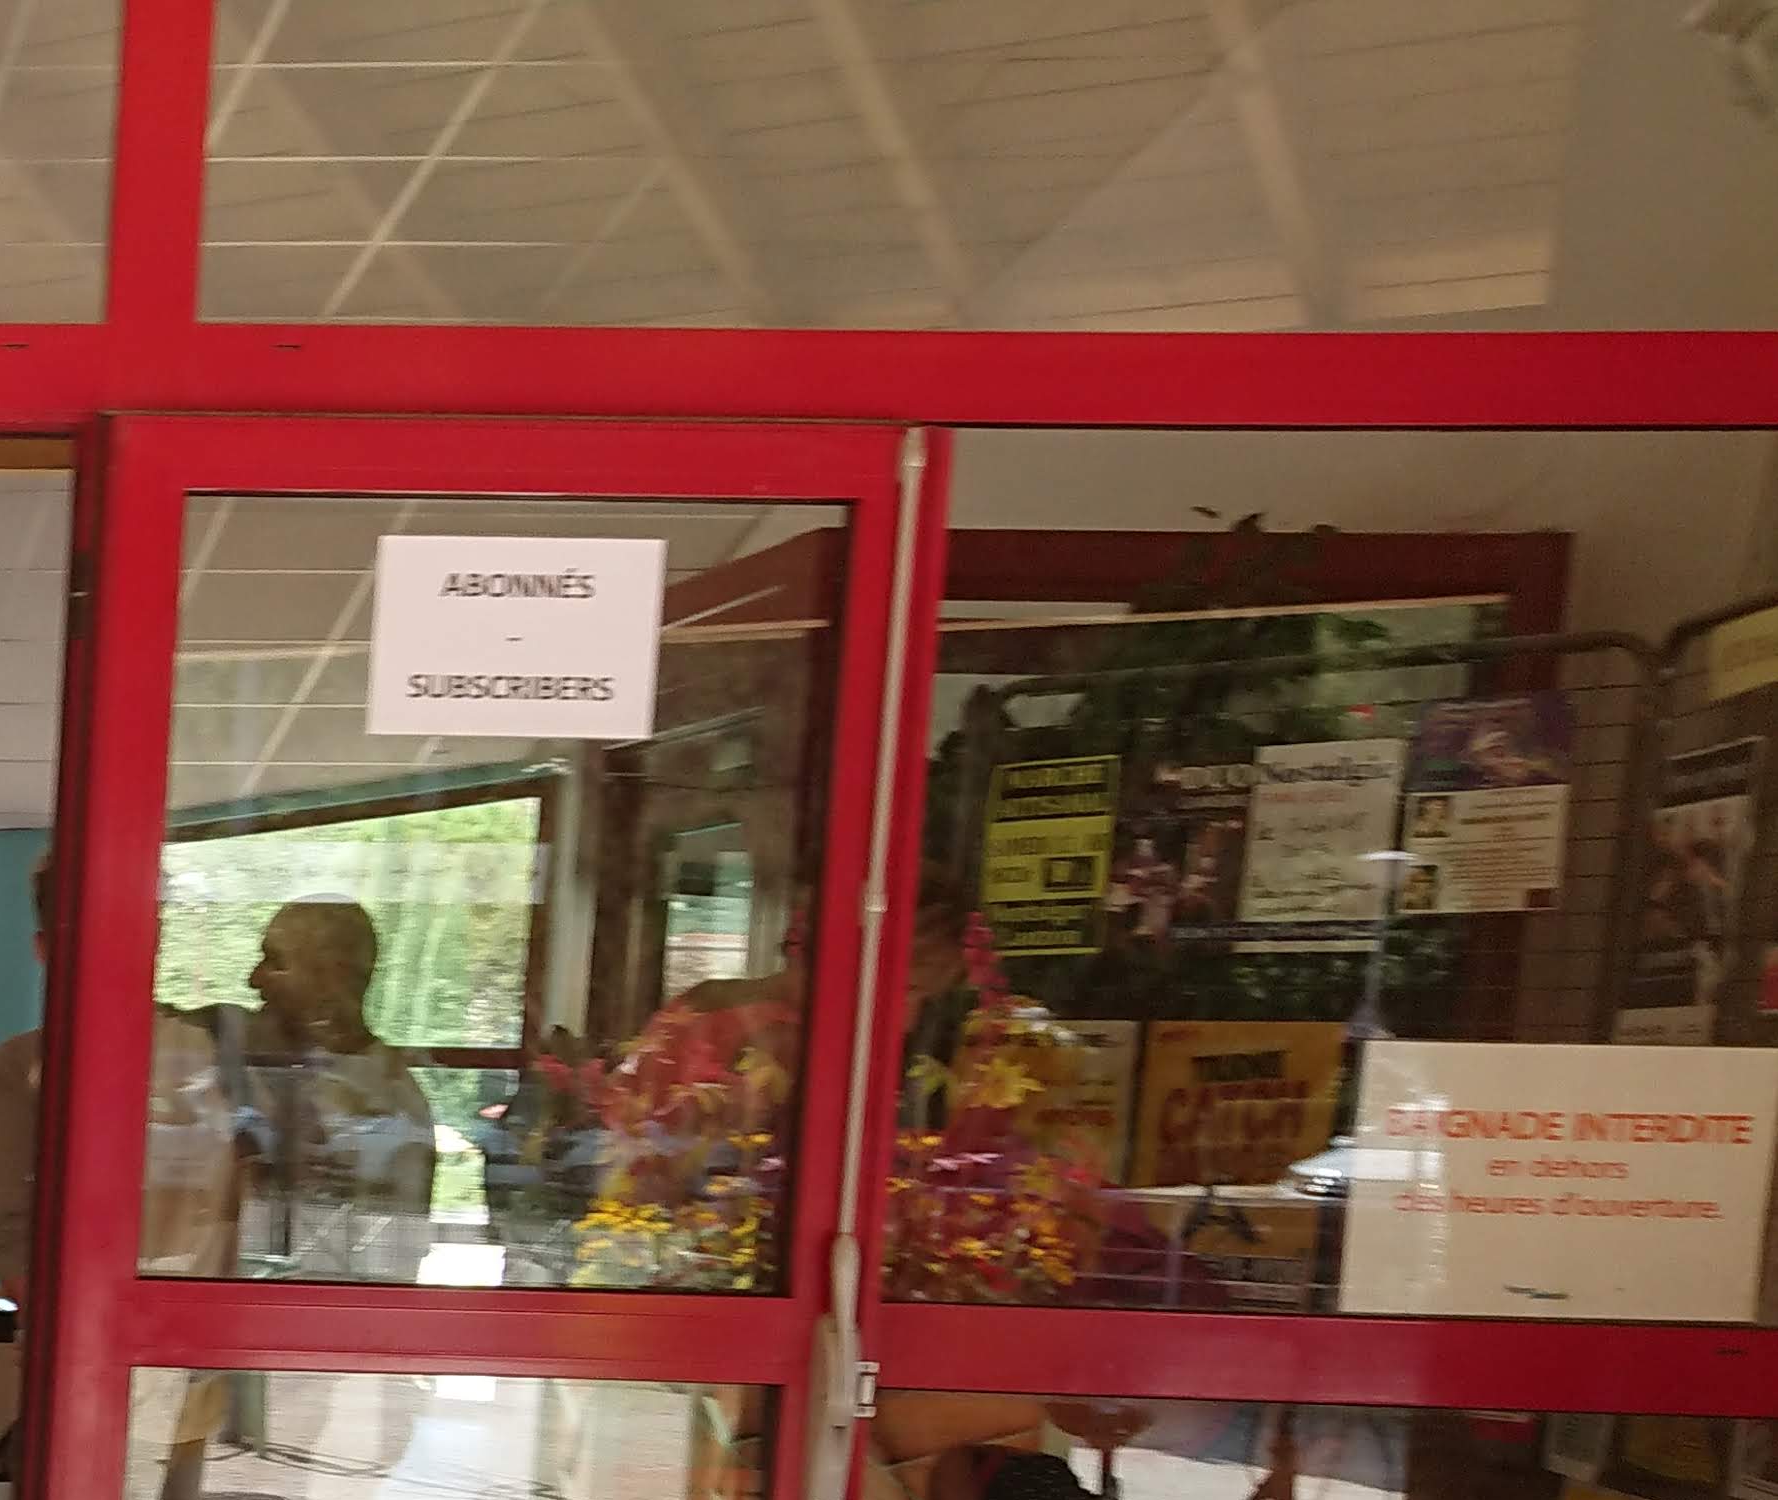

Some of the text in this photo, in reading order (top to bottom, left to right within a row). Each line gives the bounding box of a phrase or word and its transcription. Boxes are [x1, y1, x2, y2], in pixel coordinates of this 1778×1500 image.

[440, 568, 594, 598] ABONNÉS
[405, 674, 614, 701] SUBSCRIBERS
[1573, 1112, 1756, 1145] INTERDITE
[1487, 1155, 1630, 1179] en dehors
[1450, 1189, 1545, 1214] heures
